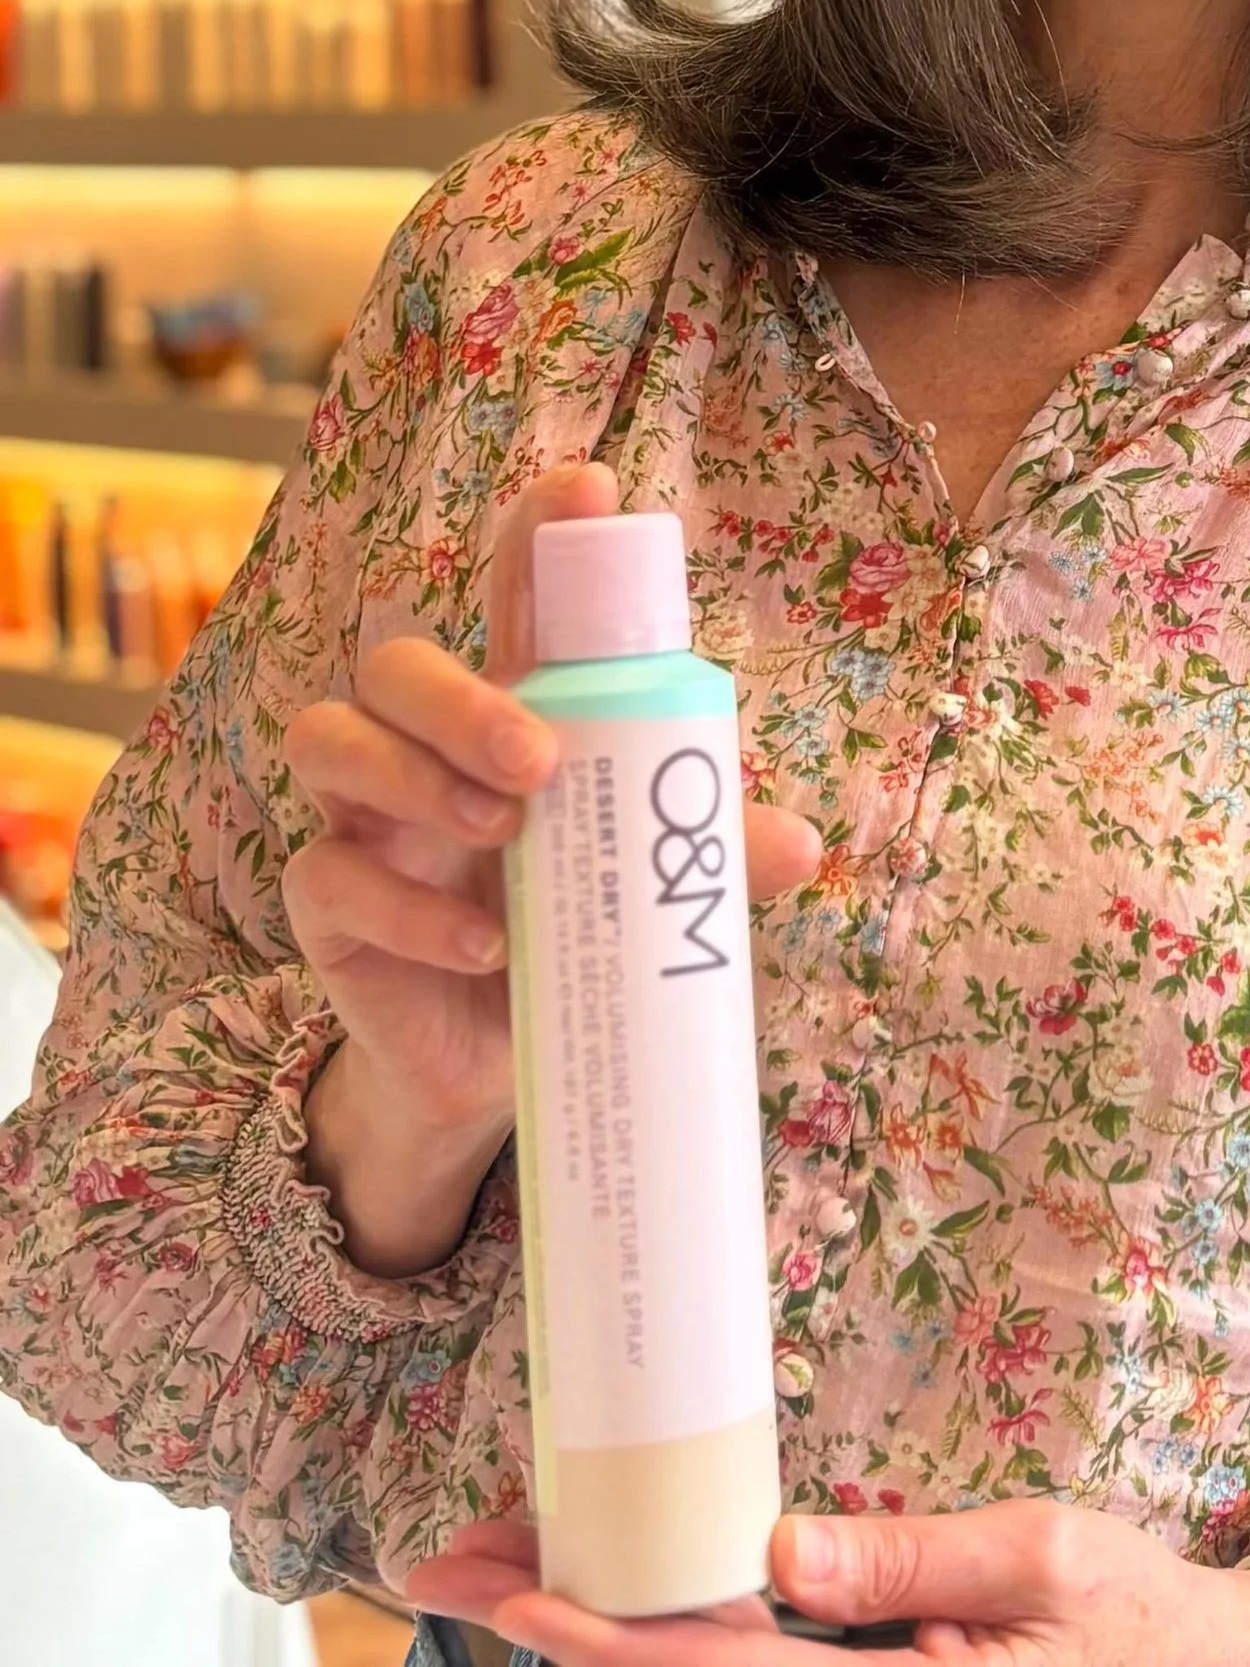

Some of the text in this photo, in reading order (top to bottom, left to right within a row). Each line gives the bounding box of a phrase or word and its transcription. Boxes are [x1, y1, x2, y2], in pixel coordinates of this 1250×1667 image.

[568, 758, 592, 834] SPRAY
[594, 756, 619, 858] DESERT
[573, 841, 599, 948] TEXTURE
[650, 748, 731, 979] O&M
[605, 952, 632, 1111] VOLUMISING
[584, 1041, 611, 1220] VOLUMISANTE
[613, 1119, 635, 1167] DRY
[616, 1176, 641, 1283] TEXTURE
[622, 1291, 646, 1370] SPRAY
